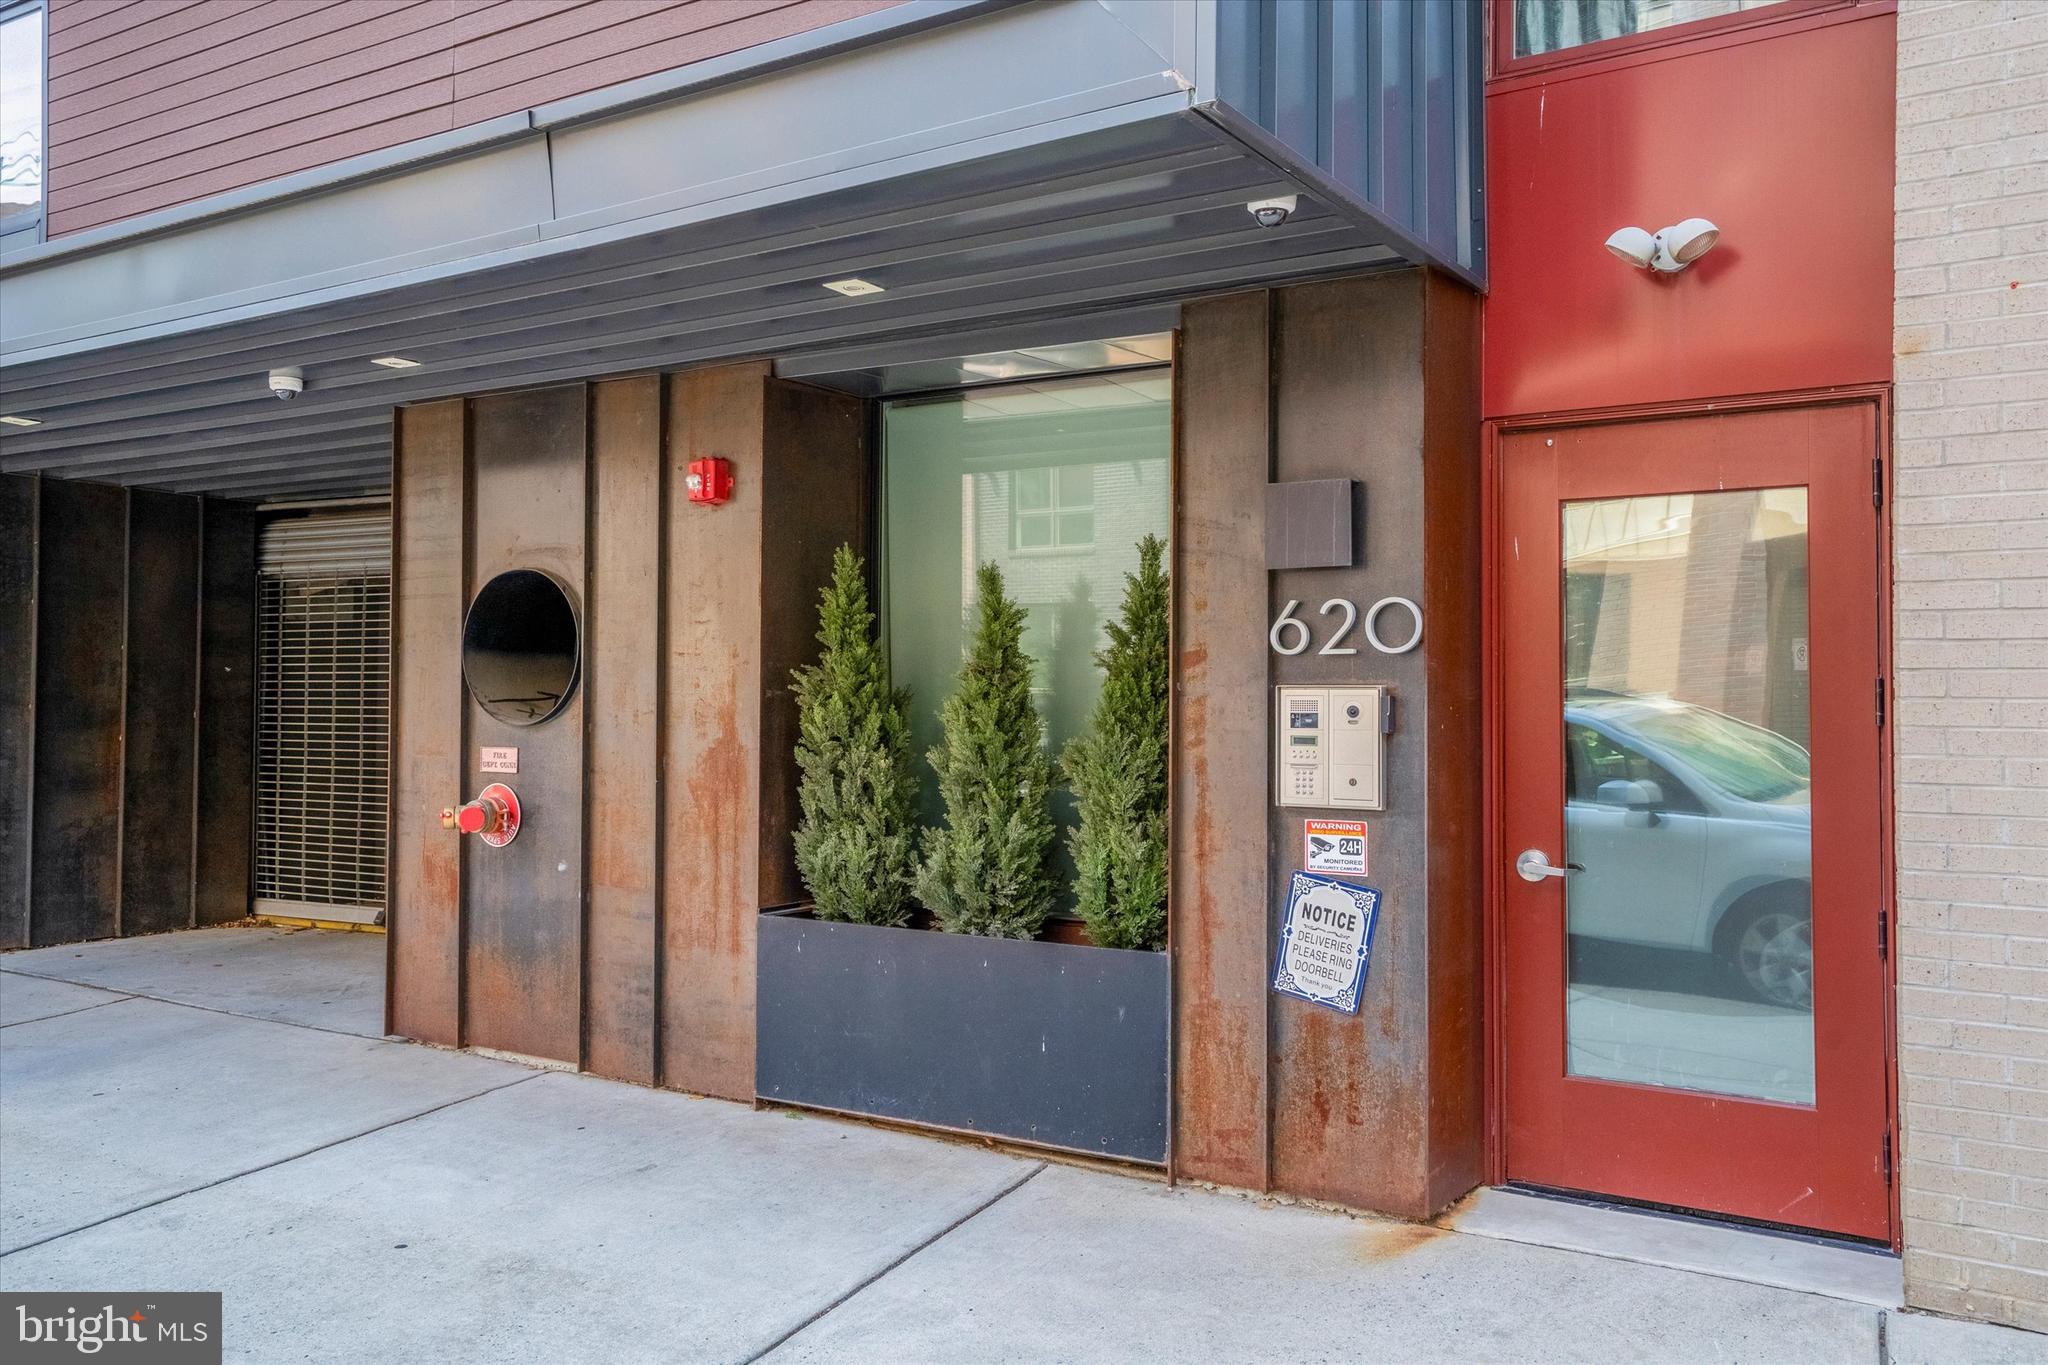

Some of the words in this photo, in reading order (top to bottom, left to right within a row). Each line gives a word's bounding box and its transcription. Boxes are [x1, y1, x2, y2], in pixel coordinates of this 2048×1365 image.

[1270, 597, 1423, 655] 620
[1311, 822, 1362, 831] WARNING
[1340, 841, 1362, 854] 24H
[1324, 858, 1363, 866] MONITORED
[1301, 902, 1357, 932] NOTICE
[1297, 930, 1353, 955] DELIVERIES
[1292, 943, 1328, 963] PLEASE
[1329, 954, 1353, 970] RING
[1294, 959, 1343, 983] DOORBELL
[1301, 975, 1320, 987] Thank
